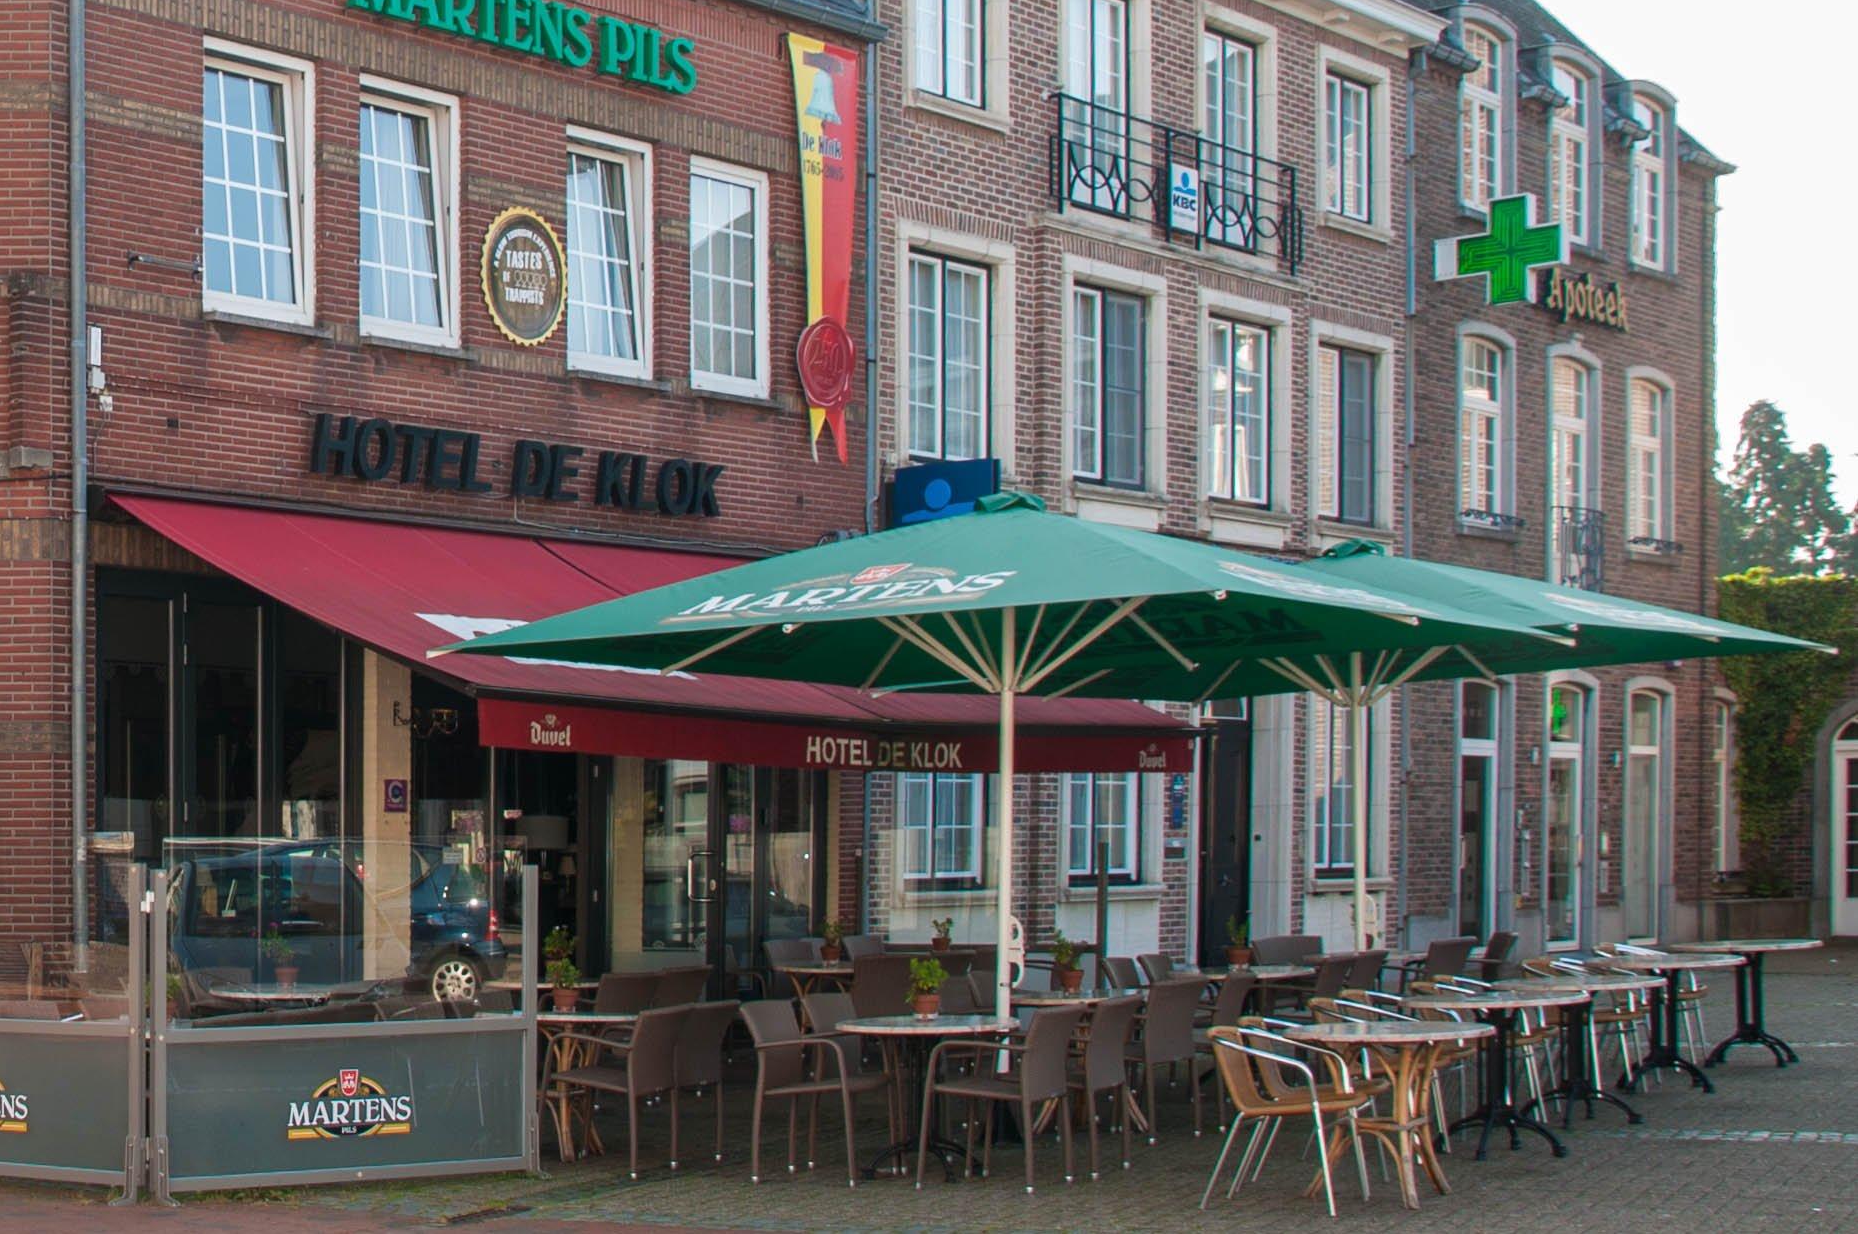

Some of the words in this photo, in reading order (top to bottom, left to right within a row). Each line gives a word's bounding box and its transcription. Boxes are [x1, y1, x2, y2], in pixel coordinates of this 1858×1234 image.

[596, 15, 697, 95] PILS
[1173, 193, 1196, 212] KBC
[506, 250, 542, 270] TASTES
[504, 287, 544, 305] TRAPPISTS
[1546, 267, 1630, 331] Apoteek
[311, 413, 492, 493] HOTEL
[511, 439, 584, 502] DE
[594, 450, 727, 517] KLOK
[678, 570, 1018, 616] MARTENS
[530, 721, 571, 746] Duvel
[806, 736, 872, 766] HOTEL
[876, 741, 907, 767] DE
[910, 742, 963, 768] KLOK
[288, 1096, 412, 1126] MARTENS
